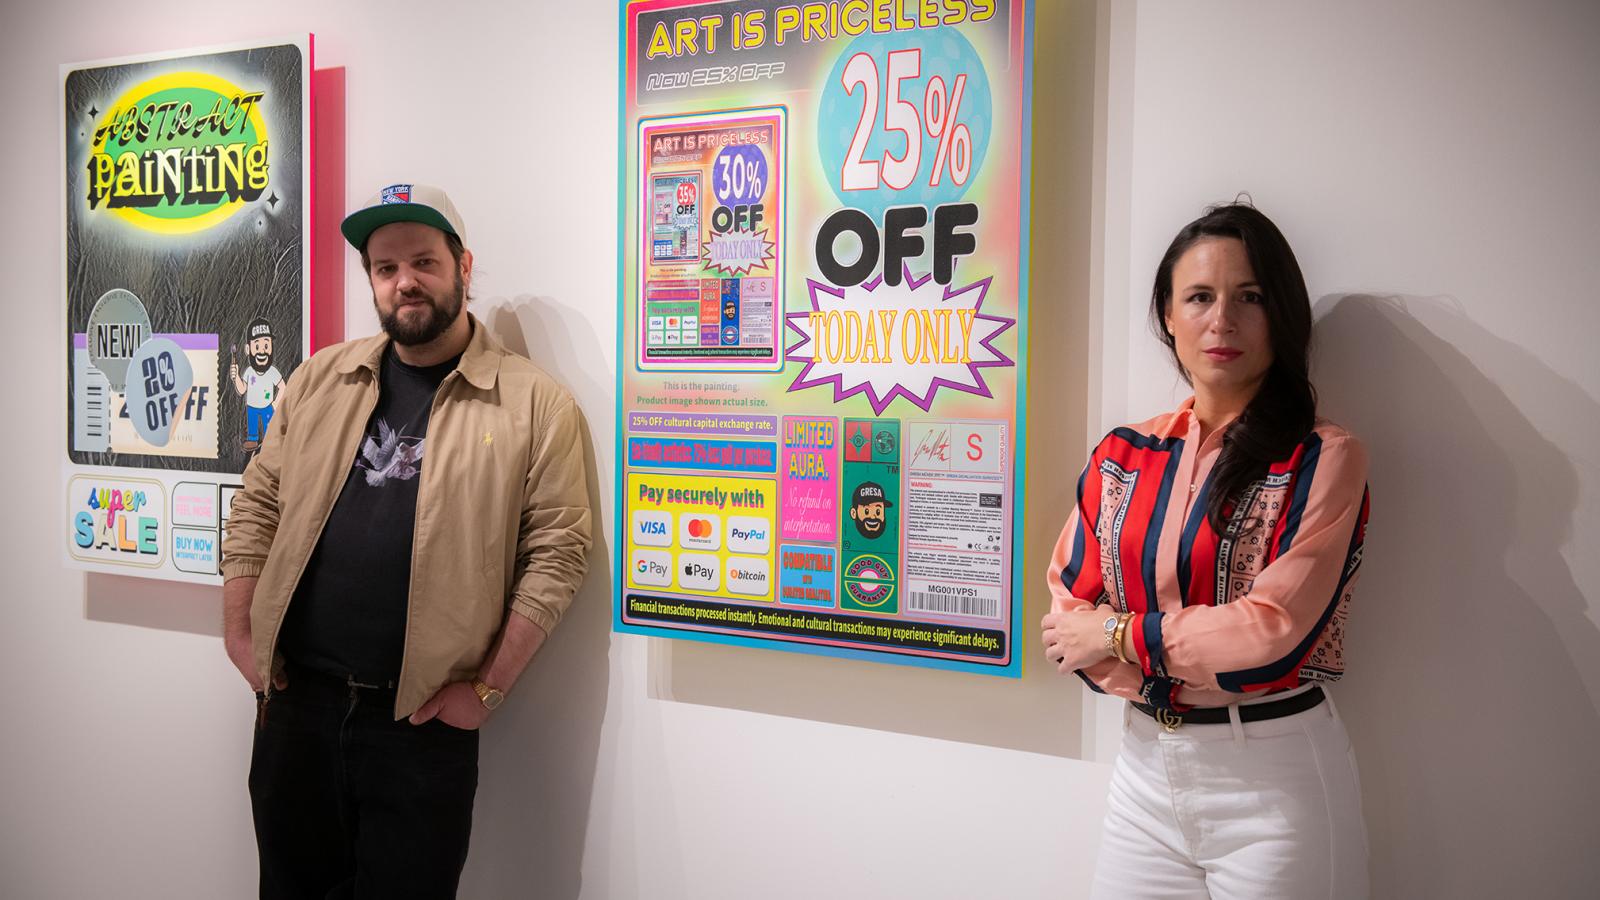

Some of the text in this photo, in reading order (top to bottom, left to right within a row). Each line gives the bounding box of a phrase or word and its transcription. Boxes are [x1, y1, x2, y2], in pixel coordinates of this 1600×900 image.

[646, 0, 998, 60] ART IS PRICELESS
[646, 62, 785, 91] NOW 25% OFF
[94, 91, 265, 146] ABSTRACT
[840, 48, 972, 191] 25%
[653, 129, 769, 152] ART IS PRICELESS
[718, 153, 762, 200] 30%
[678, 185, 695, 203] 35%
[676, 204, 696, 215] OFF
[712, 203, 764, 233] OFF
[815, 203, 979, 287] OFF
[97, 324, 141, 358] NEW!
[252, 323, 270, 337] GRESA
[809, 310, 897, 364] TODAY
[901, 308, 976, 365] ONLY
[664, 382, 740, 393] This is the painting.
[145, 393, 178, 431] OFF
[637, 396, 768, 407] Product image shown actual size.
[632, 416, 773, 431] 25% OFF cultural capital exchange rate.
[784, 420, 834, 449] LIMITED
[966, 433, 983, 461] S
[789, 452, 829, 481] AURA.
[639, 484, 765, 510] Pay securely with
[799, 488, 823, 516] refund
[822, 498, 832, 510] on
[860, 487, 882, 498] GRESA
[87, 487, 147, 528] super
[74, 511, 158, 555] SALE
[640, 520, 666, 535] VISA
[732, 528, 765, 540] PayPal
[176, 535, 213, 552] BUY NOW
[637, 559, 668, 577] G Pay
[693, 564, 714, 581] Pay
[783, 552, 833, 572] COMPATIBLE
[850, 559, 872, 575] GOOD
[874, 562, 889, 578] GUY
[738, 570, 766, 582] bitcoin
[850, 584, 888, 602] GUARANTEE
[928, 585, 978, 597] MG001VPS1
[630, 599, 999, 651] Financial transactions processed instantly. Emotional and cultural transactions may experience significant delays.
